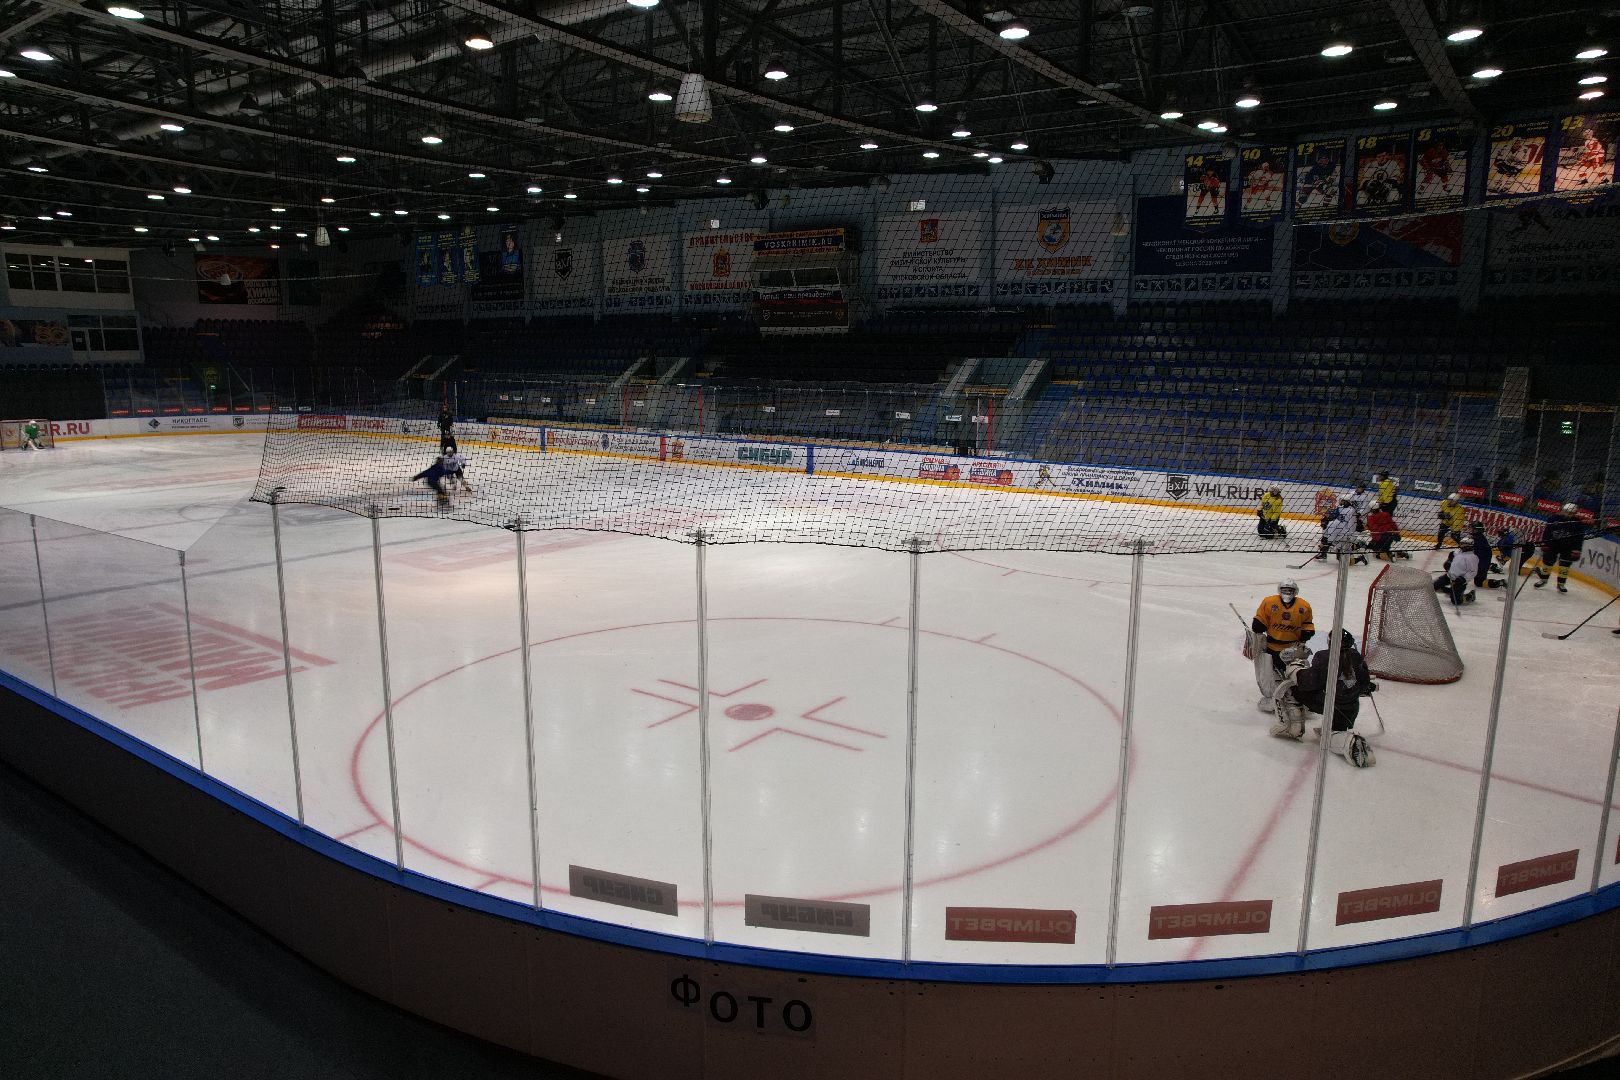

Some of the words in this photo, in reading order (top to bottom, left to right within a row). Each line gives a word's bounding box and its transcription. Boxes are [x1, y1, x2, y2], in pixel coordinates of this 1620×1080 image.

[1417, 128, 1432, 142] 8
[1491, 125, 1514, 138] 20
[1358, 137, 1378, 150] 18
[1242, 148, 1261, 161] 10
[1185, 155, 1204, 168] 14
[764, 237, 833, 249] VOSKRHIMIK.RU
[38, 422, 90, 436] HR.RU
[738, 446, 793, 464] СИБУР
[1195, 482, 1265, 500] VHLRU.R
[670, 973, 813, 1034] ФОТО
